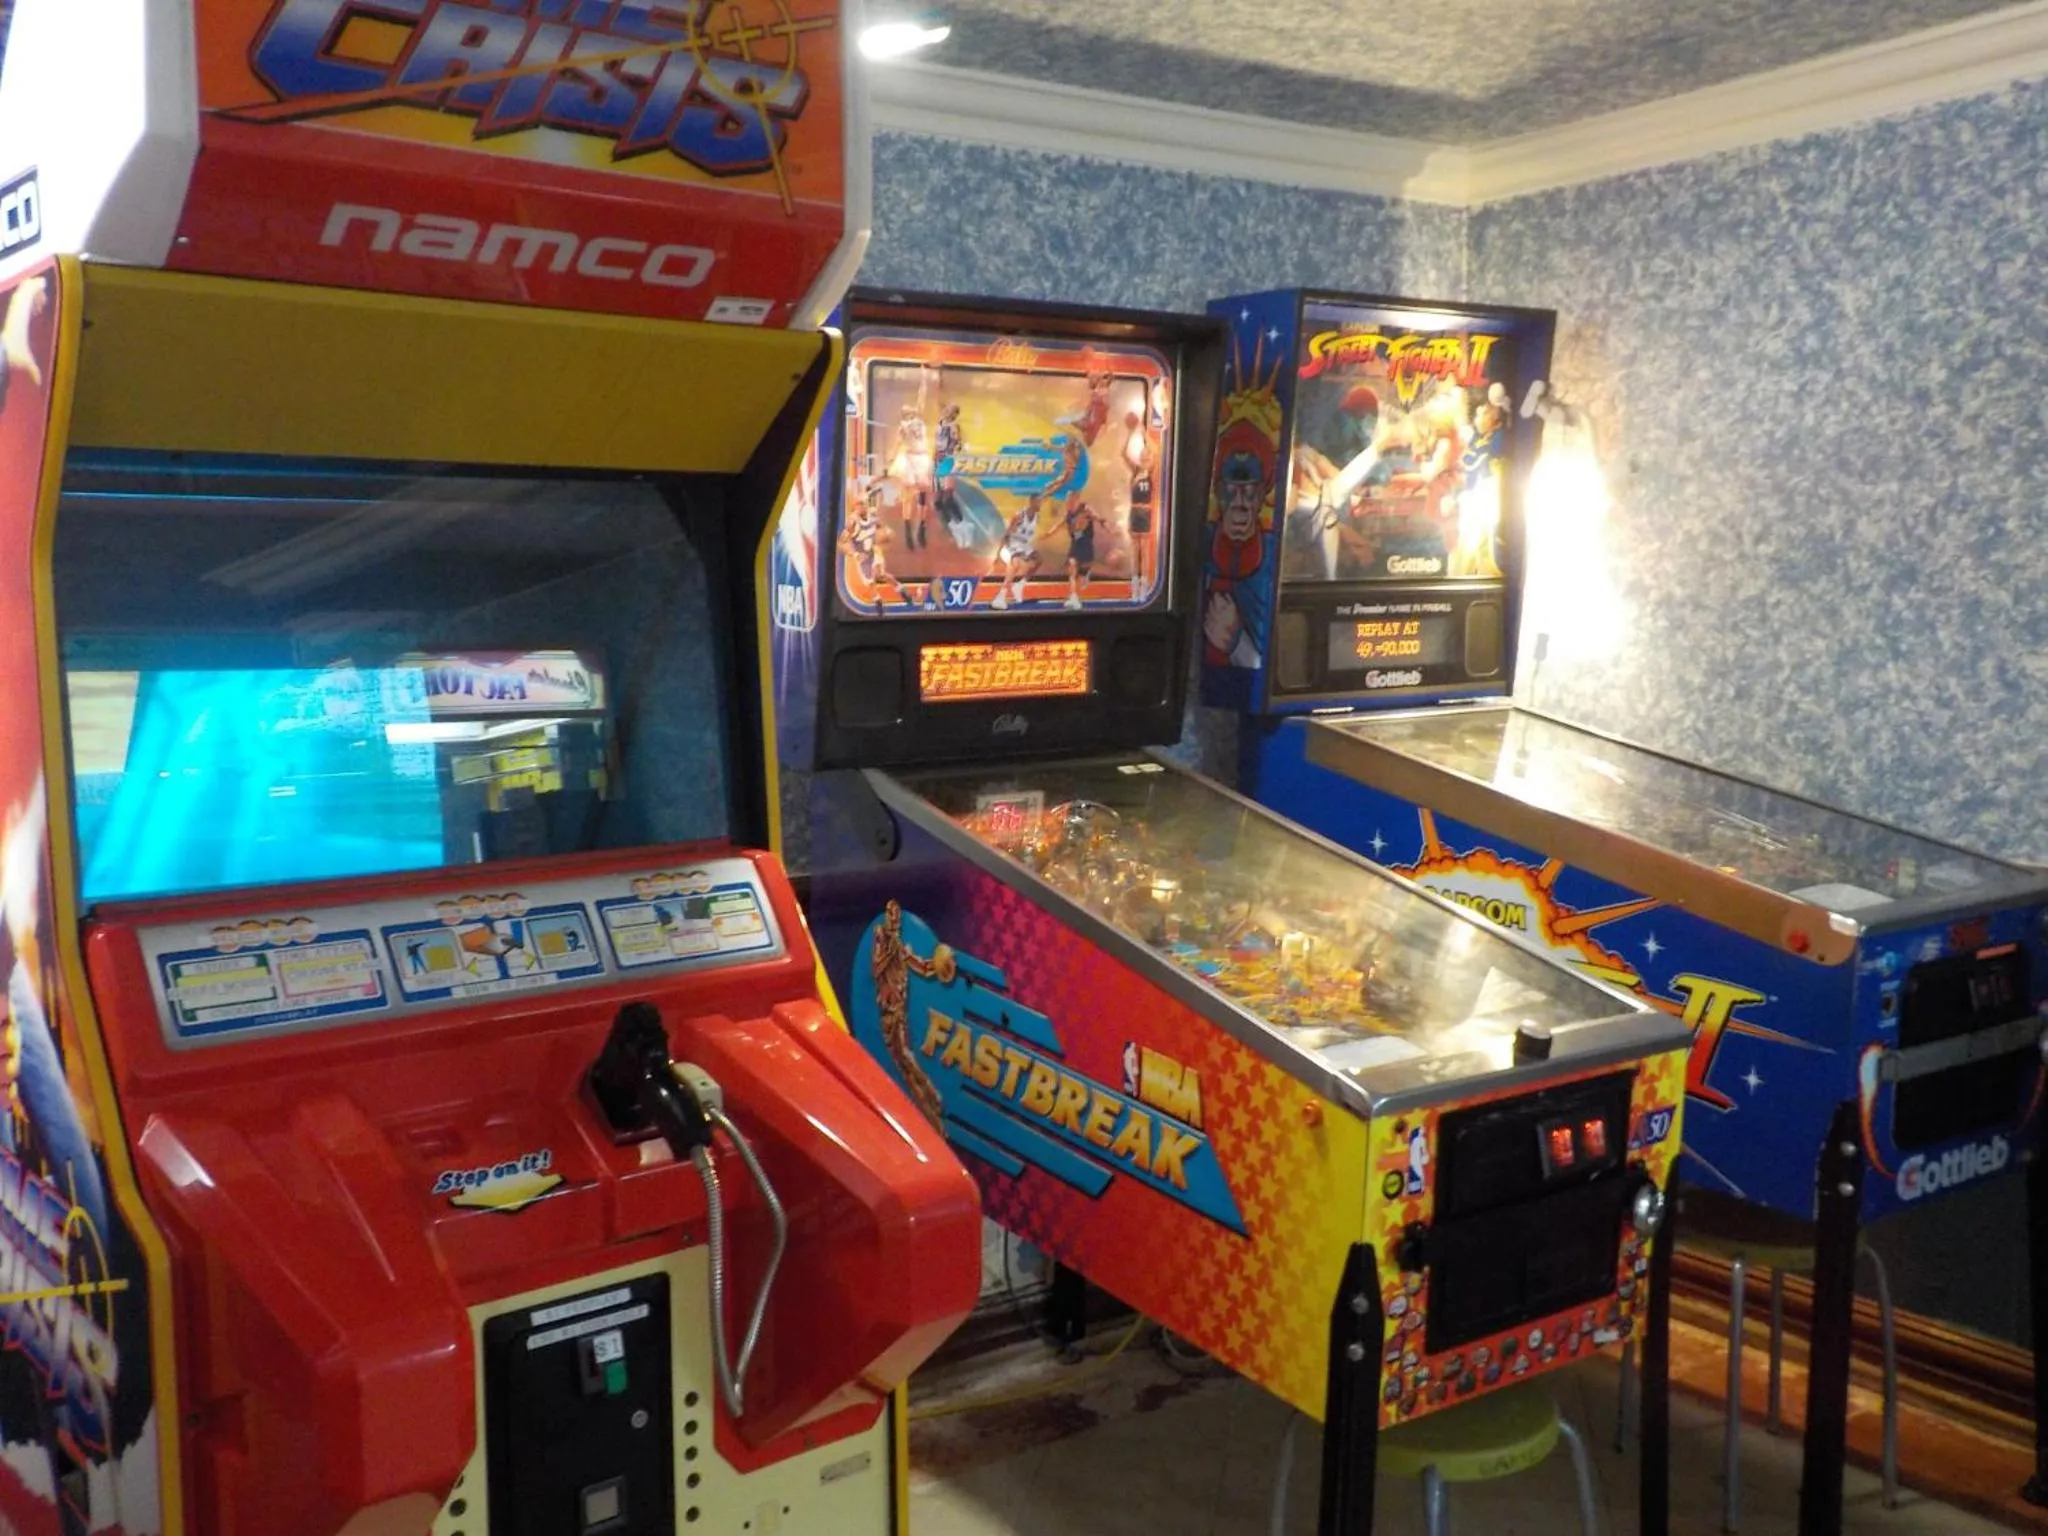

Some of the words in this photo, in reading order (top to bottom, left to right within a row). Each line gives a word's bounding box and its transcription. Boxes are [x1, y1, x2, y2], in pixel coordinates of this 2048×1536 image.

[248, 0, 811, 177] CRISIS
[319, 202, 717, 289] namco
[1296, 330, 1379, 379] STREET
[954, 455, 1059, 473] FASTBREAK
[1387, 555, 1442, 574] Gottlieb
[944, 579, 973, 606] 50
[1356, 622, 1401, 638] REPLAY
[1402, 620, 1421, 635] AT
[1365, 669, 1423, 689] Gottlieb
[921, 1008, 1203, 1191] FASTBREAK
[1647, 1112, 1669, 1140] 50
[435, 1169, 488, 1192] Step
[493, 1162, 519, 1177] on
[1896, 1135, 2009, 1201] Gottlieb
